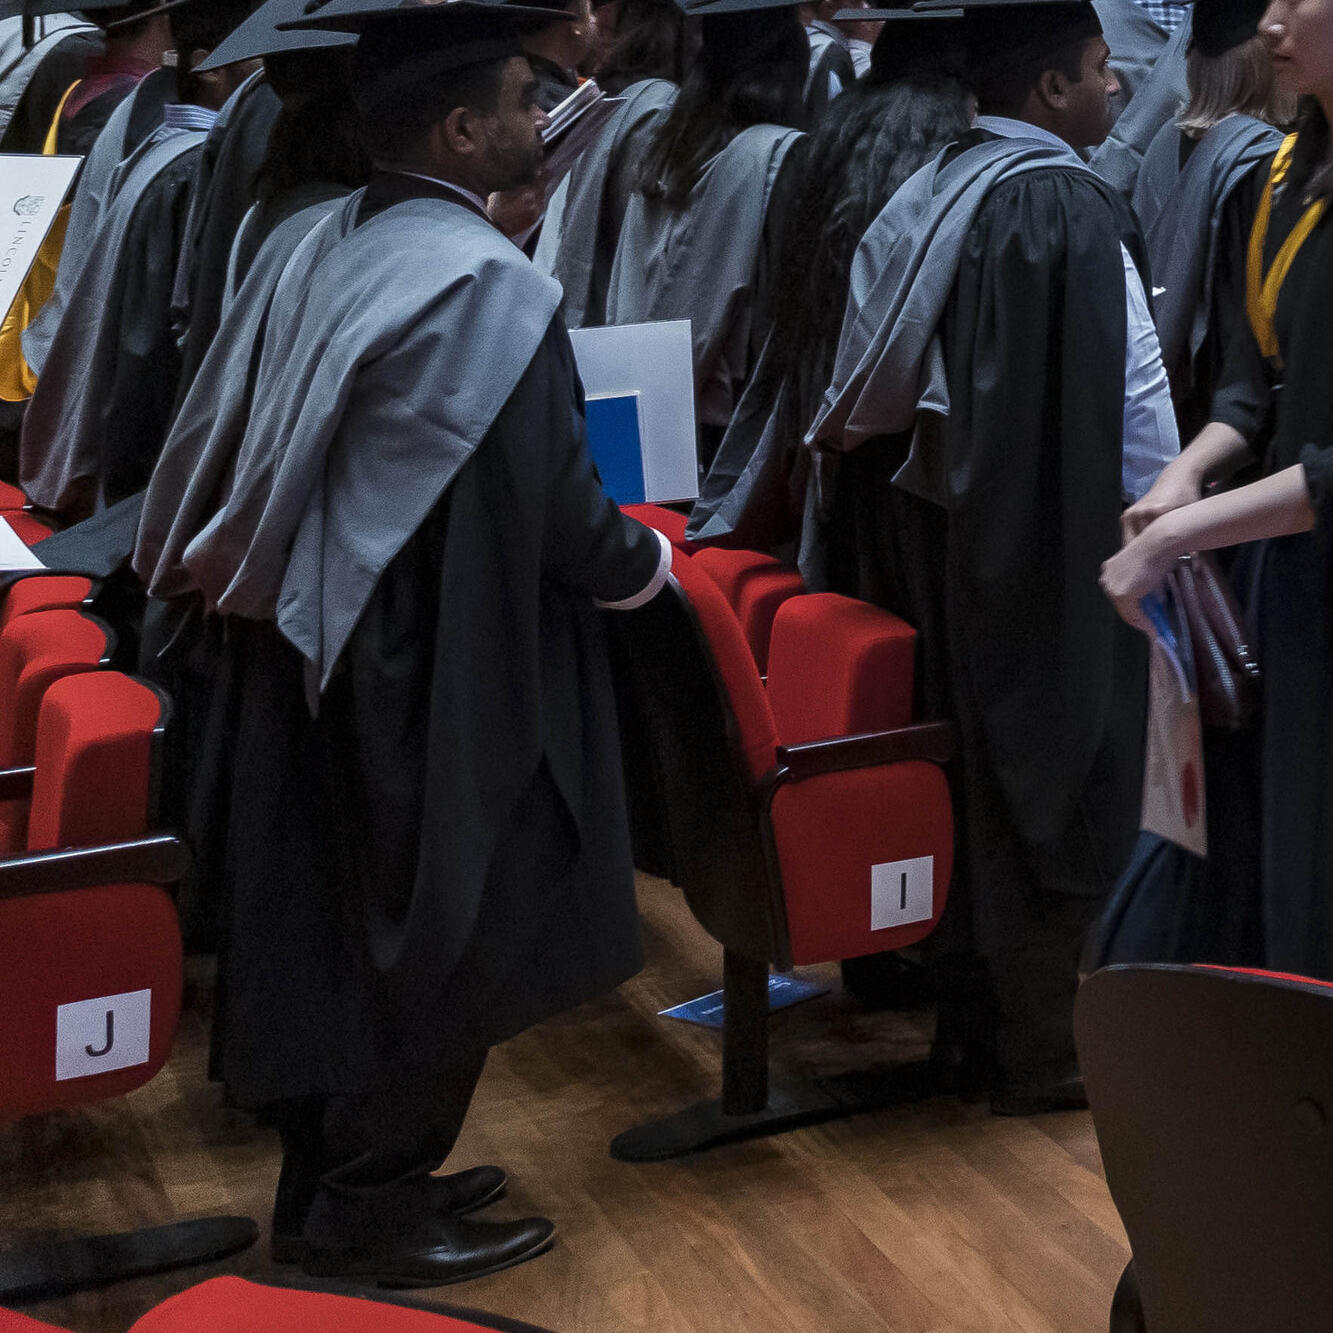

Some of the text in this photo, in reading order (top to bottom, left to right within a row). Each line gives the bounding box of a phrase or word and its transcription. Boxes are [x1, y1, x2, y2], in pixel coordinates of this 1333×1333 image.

[0, 221, 31, 281] LINCOL
[900, 872, 907, 910] I
[85, 1010, 114, 1057] J
